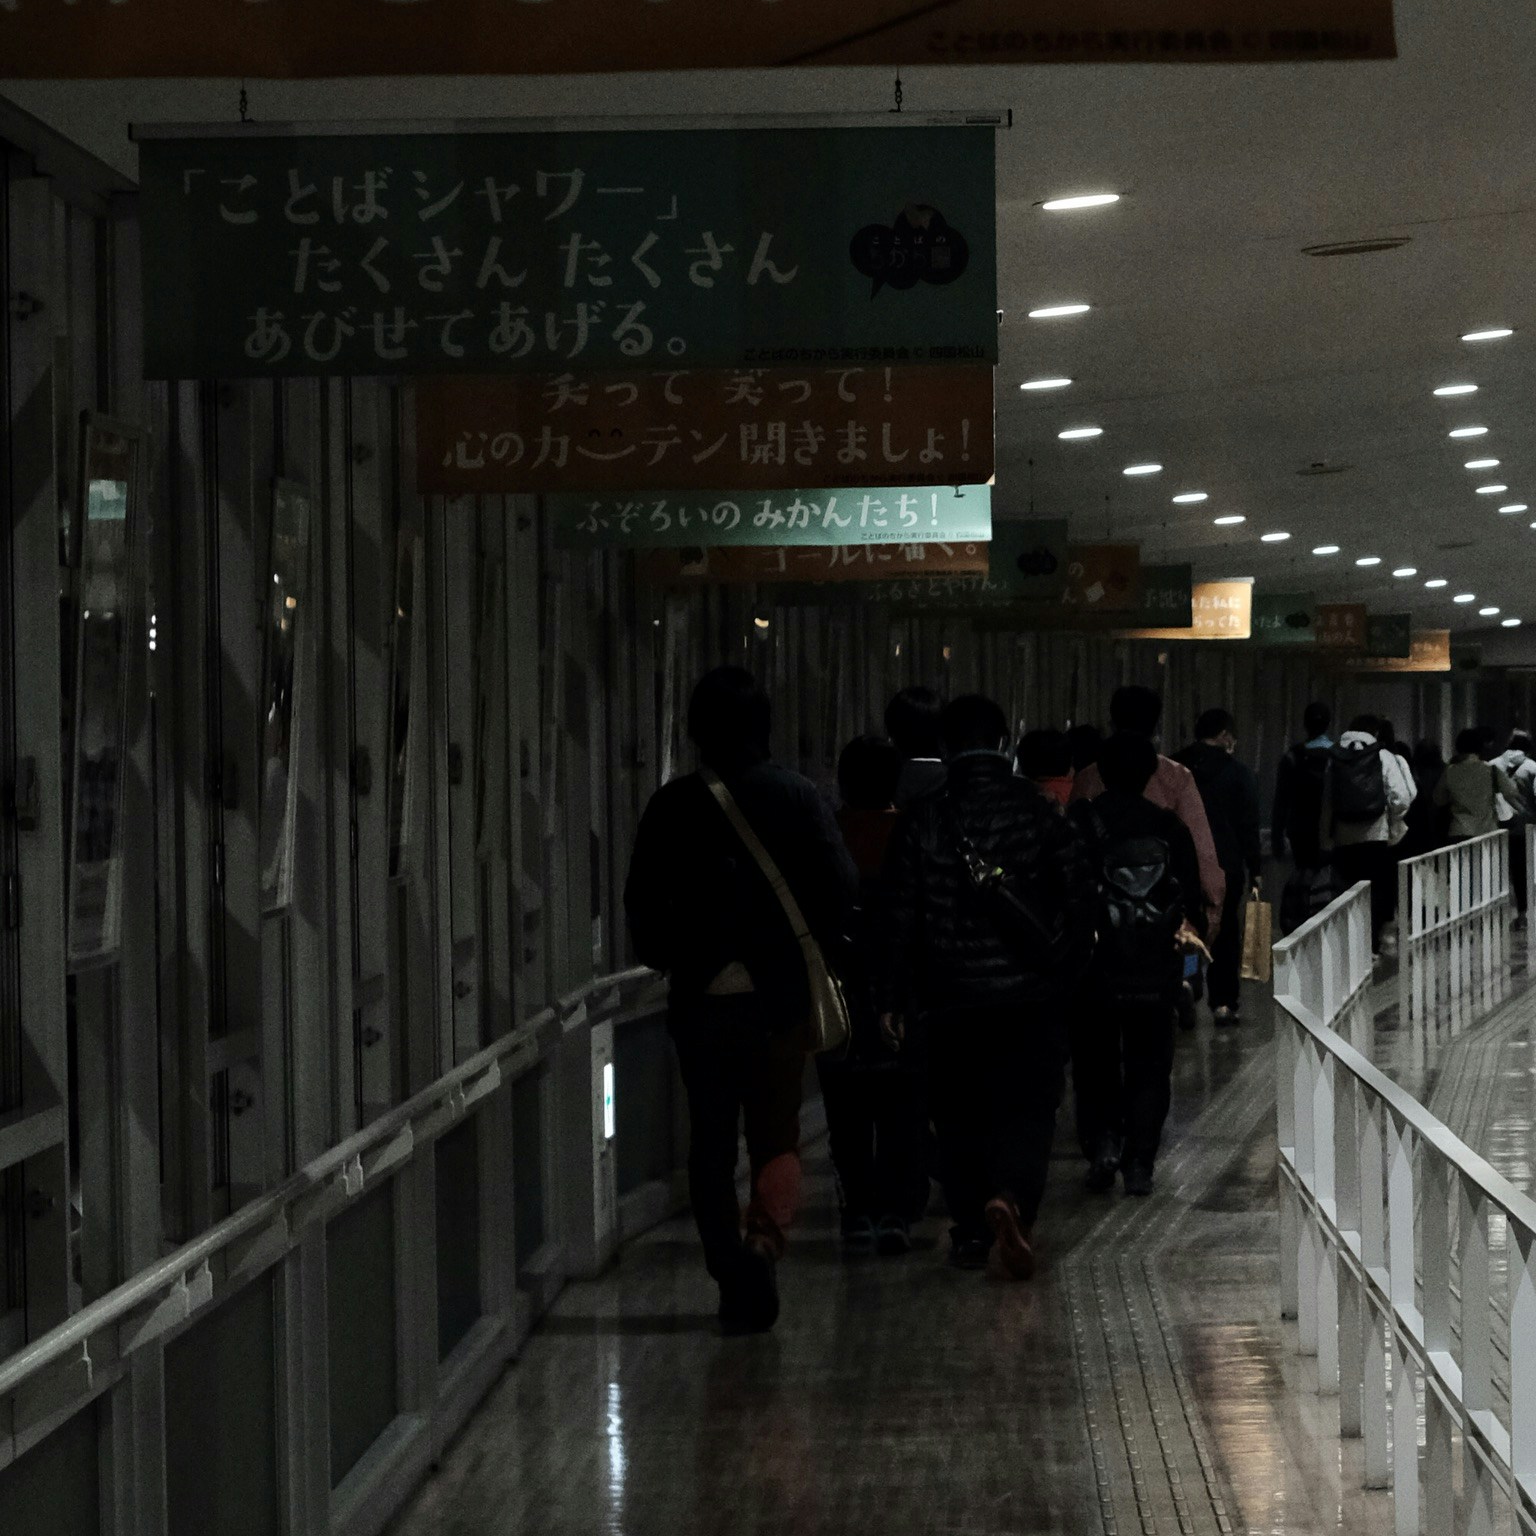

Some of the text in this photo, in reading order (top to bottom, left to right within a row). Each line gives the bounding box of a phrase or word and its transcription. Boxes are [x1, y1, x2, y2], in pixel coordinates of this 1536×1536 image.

[243, 303, 690, 363] あびせてあげる。
